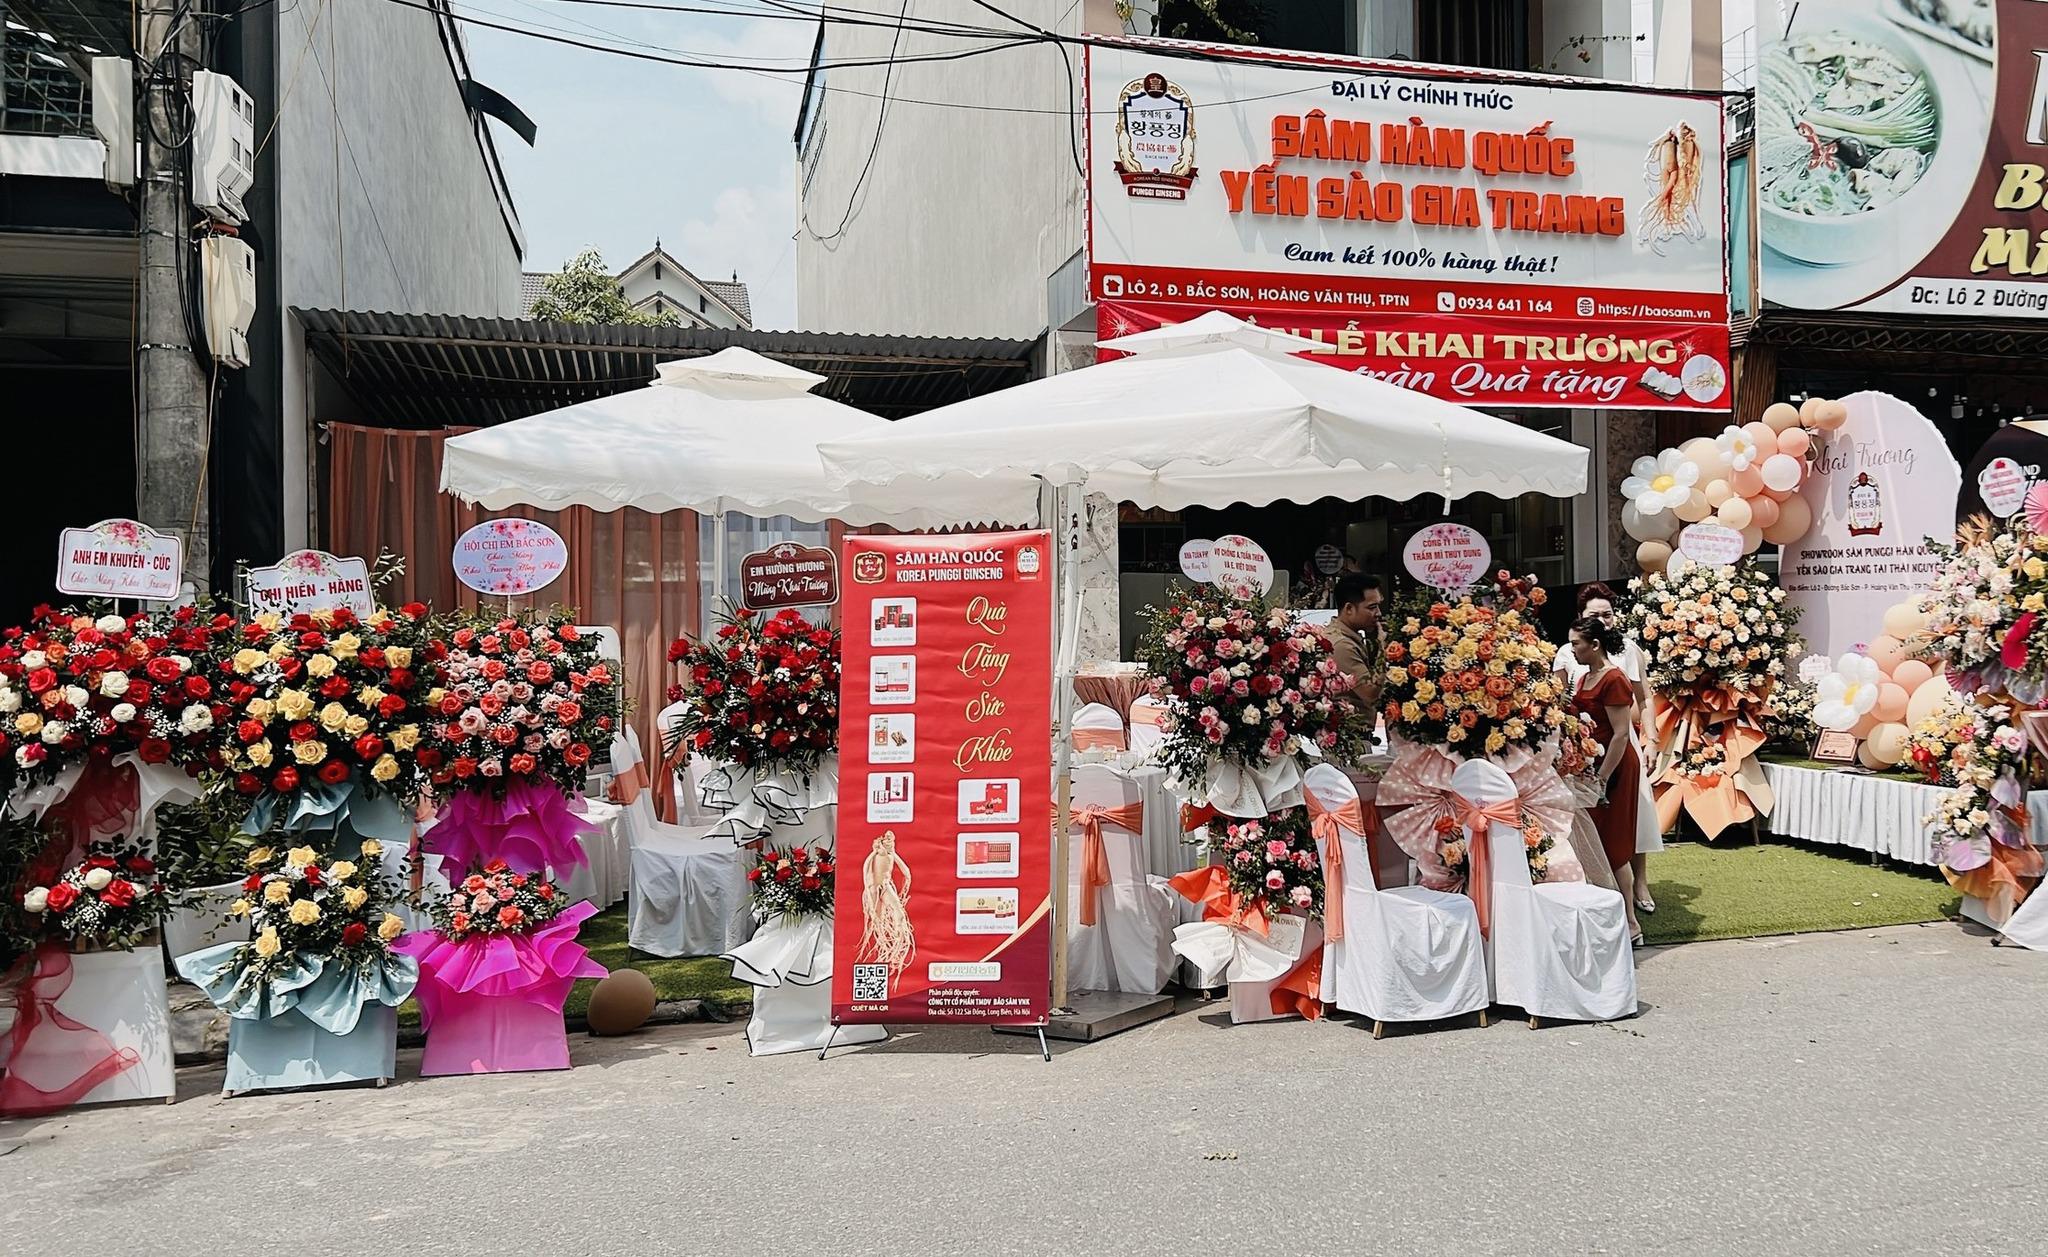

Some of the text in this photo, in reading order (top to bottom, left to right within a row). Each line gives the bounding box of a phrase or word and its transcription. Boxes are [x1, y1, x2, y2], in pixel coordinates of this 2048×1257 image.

[1331, 79, 1514, 111] ĐẠI LÝ CHÍNH THỨC
[1271, 108, 1575, 177] SÂM HÀN QUỐC
[1219, 159, 1625, 237] YẾN SÀO GIA TRANG
[1993, 163, 2048, 212] B
[1284, 242, 1336, 263] Cam
[1342, 244, 1376, 266] kết
[1381, 247, 1436, 268] 100%
[1442, 251, 1497, 274] hàng
[1127, 280, 1410, 309] LÔ 2, Đ. BẮC SƠN, HOÀNG VĂN THỤ, TPTN
[1457, 296, 1553, 313] 0934 641 164
[1911, 285, 2048, 311] Đc: Lô 2 Đường
[1597, 303, 1712, 320] https://baosam.vn
[1310, 319, 1369, 356] LỄ
[1375, 331, 1486, 360] KHAI
[1492, 333, 1679, 365] TRƯƠNG
[1450, 361, 1532, 397] Quà
[1541, 368, 1630, 402] tặng
[464, 540, 480, 552] HỘI
[482, 540, 498, 551] CHỊ
[500, 540, 514, 549] EM
[537, 537, 556, 547] SƠN
[1443, 538, 1451, 546] TY
[1800, 548, 1844, 560] SHOWROOM
[1865, 546, 1893, 558] PUNGGI
[72, 549, 91, 565] ANH
[93, 551, 108, 566] EM
[153, 553, 171, 571] CÚC
[895, 548, 927, 566] SÂM
[929, 548, 960, 565] HÀN
[962, 546, 1005, 564] QUỐC
[750, 567, 764, 577] EM
[896, 566, 1004, 583] KOREA PUNGGI GINSENG
[1796, 563, 1811, 576] YẾN
[1813, 563, 1828, 576] SÀO
[1829, 563, 1843, 575] GIA
[1845, 563, 1871, 575] TRANG
[964, 595, 1009, 636] Quà
[956, 641, 1012, 688] Tặng
[965, 691, 1007, 724] Sức
[952, 727, 1014, 773] Khỏe
[879, 1004, 889, 1012] QR
[928, 997, 944, 1006] CÔNG
[944, 998, 951, 1006] TY
[960, 997, 975, 1006] PHẦN
[975, 998, 992, 1006] TMDV
[947, 1008, 954, 1016] Số
[987, 1009, 1000, 1017] Long
